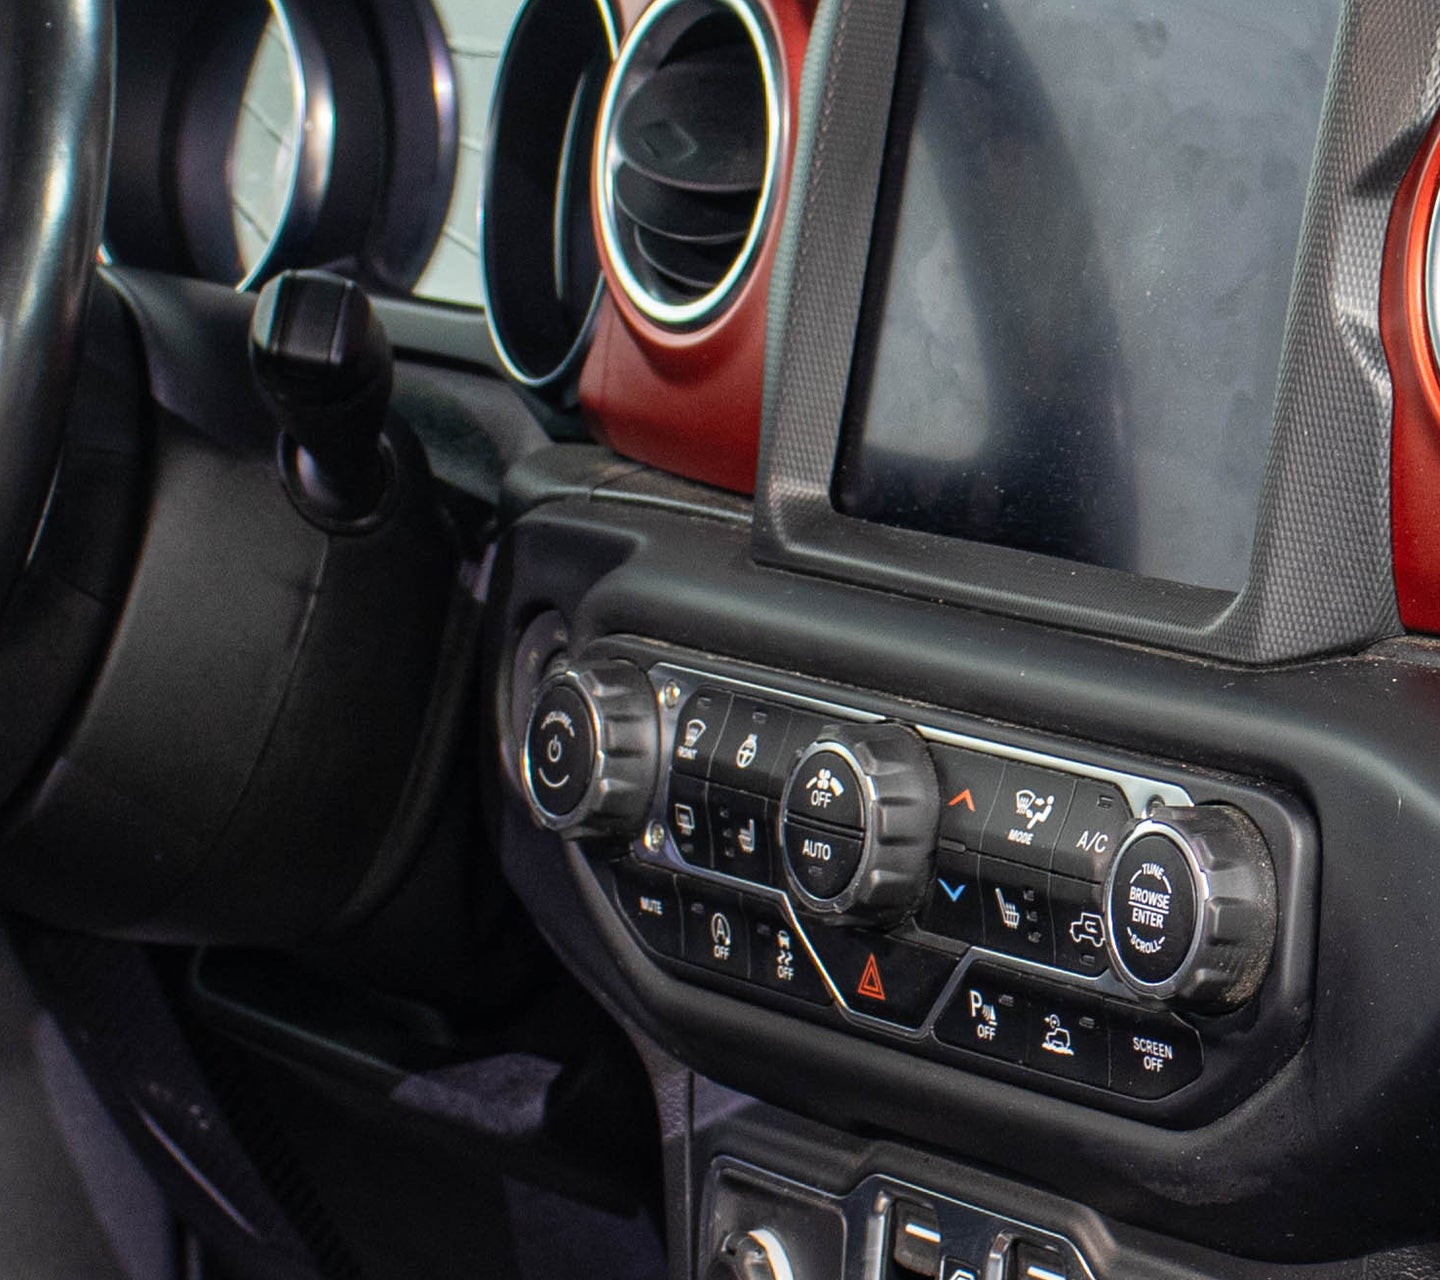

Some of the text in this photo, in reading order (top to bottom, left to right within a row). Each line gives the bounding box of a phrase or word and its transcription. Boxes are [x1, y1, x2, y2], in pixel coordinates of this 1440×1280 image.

[810, 790, 833, 808] OFF
[1007, 829, 1035, 846] MODE
[1076, 830, 1109, 853] A/C
[802, 839, 832, 861] AUTO
[1141, 862, 1165, 881] TUNE
[640, 896, 664, 916] MUTE
[1129, 886, 1171, 910] BROWSE
[1132, 909, 1164, 929] ENTER
[1130, 932, 1162, 954] SCROLL
[713, 945, 730, 961] OFF
[777, 966, 795, 981] OFF
[977, 1023, 996, 1041] OFF
[1133, 1037, 1172, 1060] SCREEN
[1143, 1055, 1164, 1072] OFF
